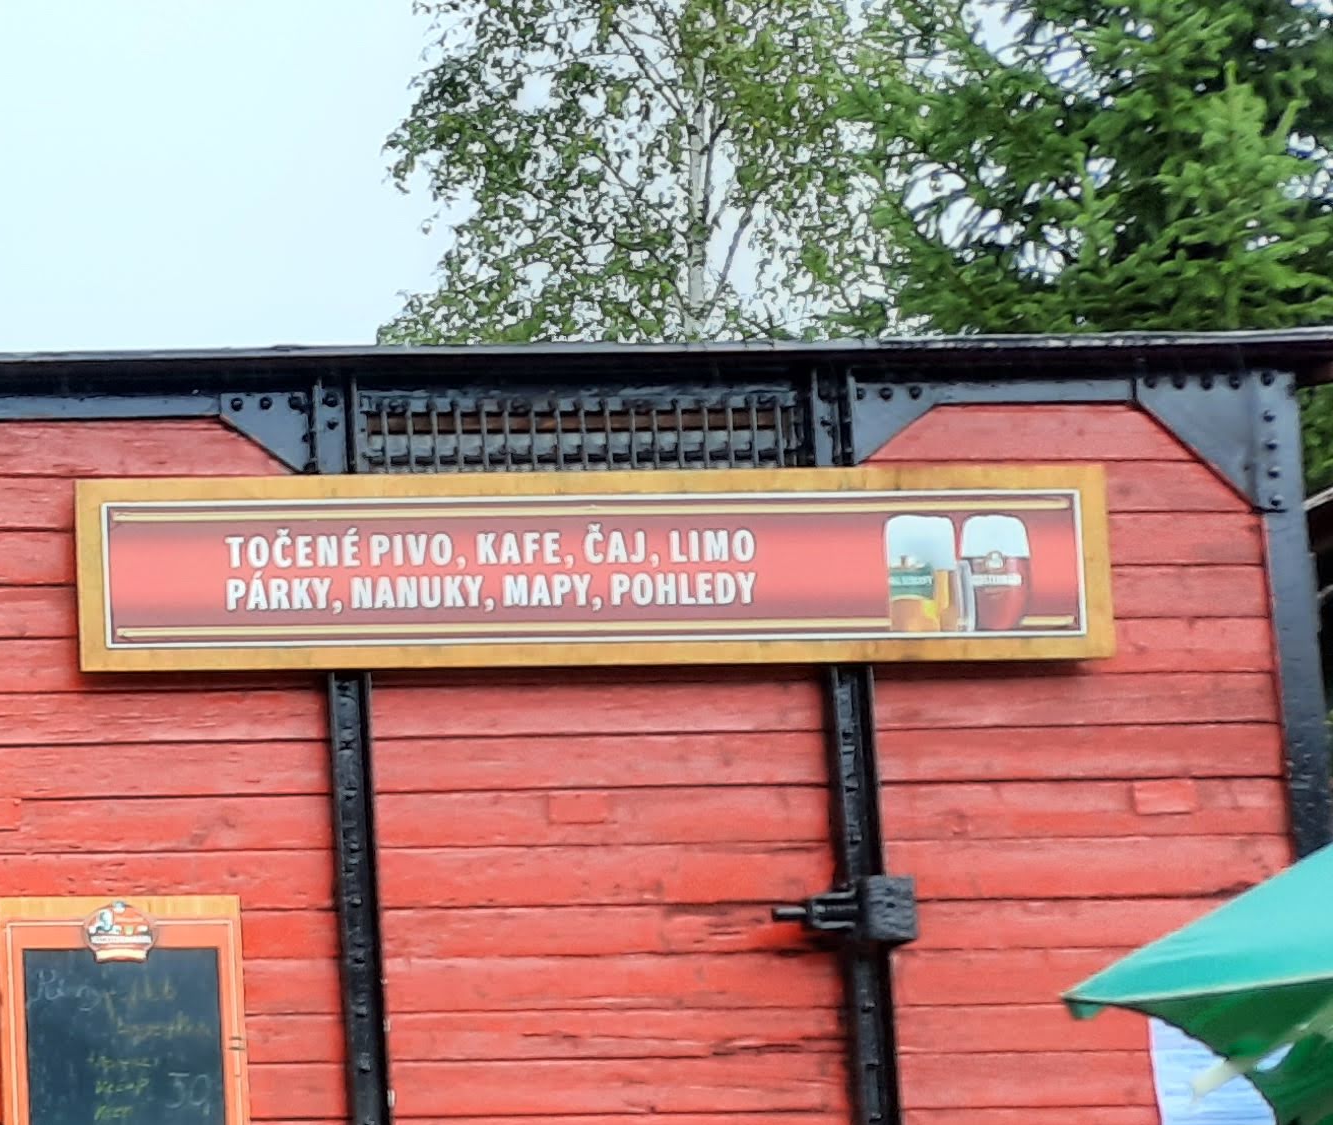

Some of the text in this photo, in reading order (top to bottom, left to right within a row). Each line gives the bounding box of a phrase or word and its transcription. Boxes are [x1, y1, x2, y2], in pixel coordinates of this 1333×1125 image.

[225, 523, 756, 570] TOČENÉ PIVO, KAFE, ČAJ, LIMO
[225, 571, 757, 616] PÁRKY, NANUKY, MAPY, POHLEDY
